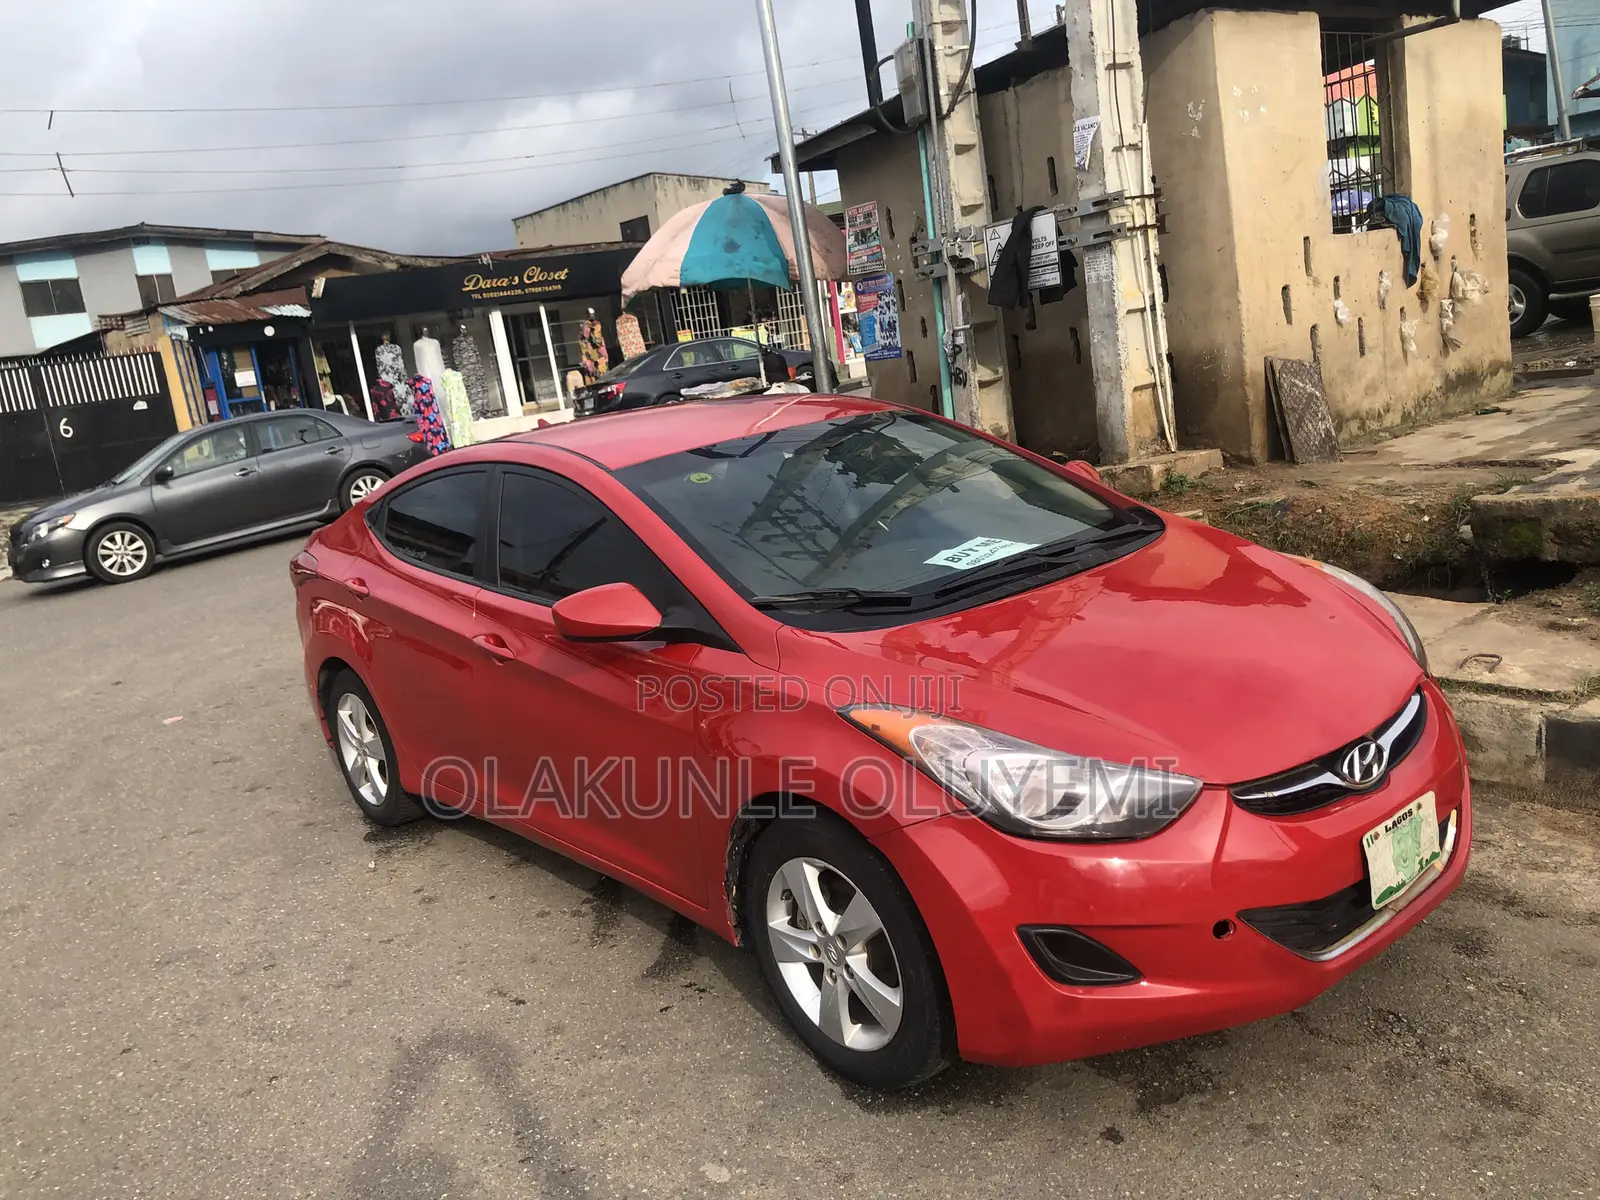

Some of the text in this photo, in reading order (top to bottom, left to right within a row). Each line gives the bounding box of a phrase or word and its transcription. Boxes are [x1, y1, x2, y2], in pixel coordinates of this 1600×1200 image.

[1032, 235, 1047, 244] VOLTS
[1045, 240, 1055, 248] OFF
[462, 266, 569, 292] Dara's Closet
[60, 417, 74, 438] 6
[943, 547, 979, 564] BUY
[1384, 808, 1414, 833] LAGOS
